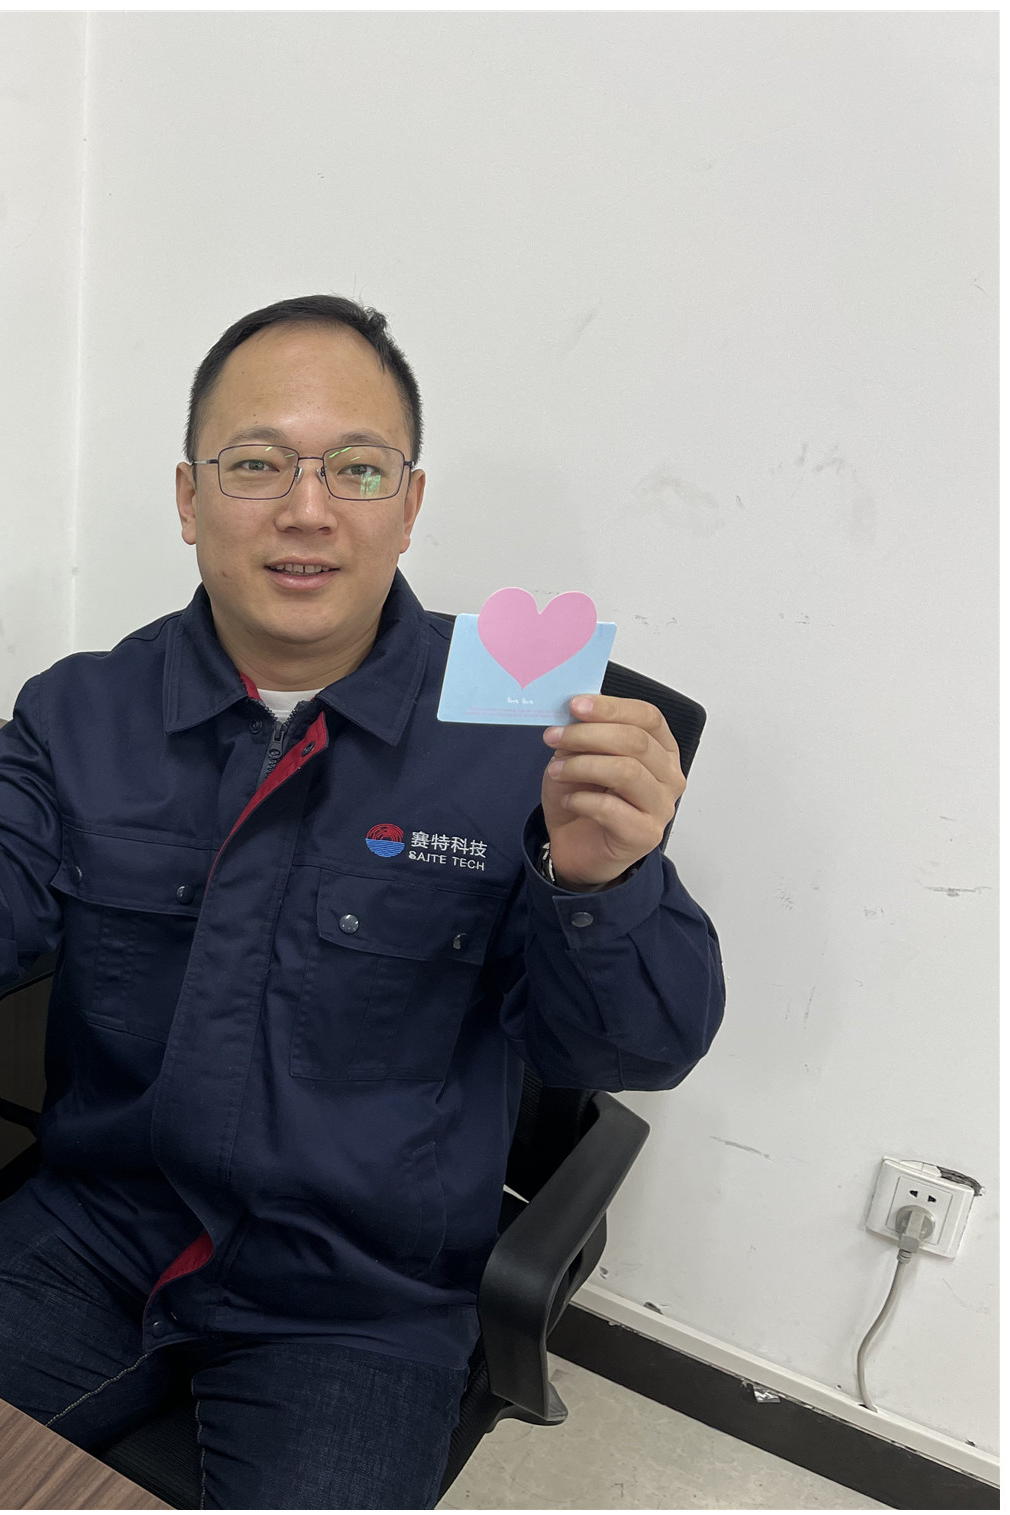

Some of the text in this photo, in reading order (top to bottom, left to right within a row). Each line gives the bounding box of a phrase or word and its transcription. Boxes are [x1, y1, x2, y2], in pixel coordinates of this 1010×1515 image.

[410, 831, 488, 858] 赛特科技
[408, 850, 485, 872] SAITE TECH
